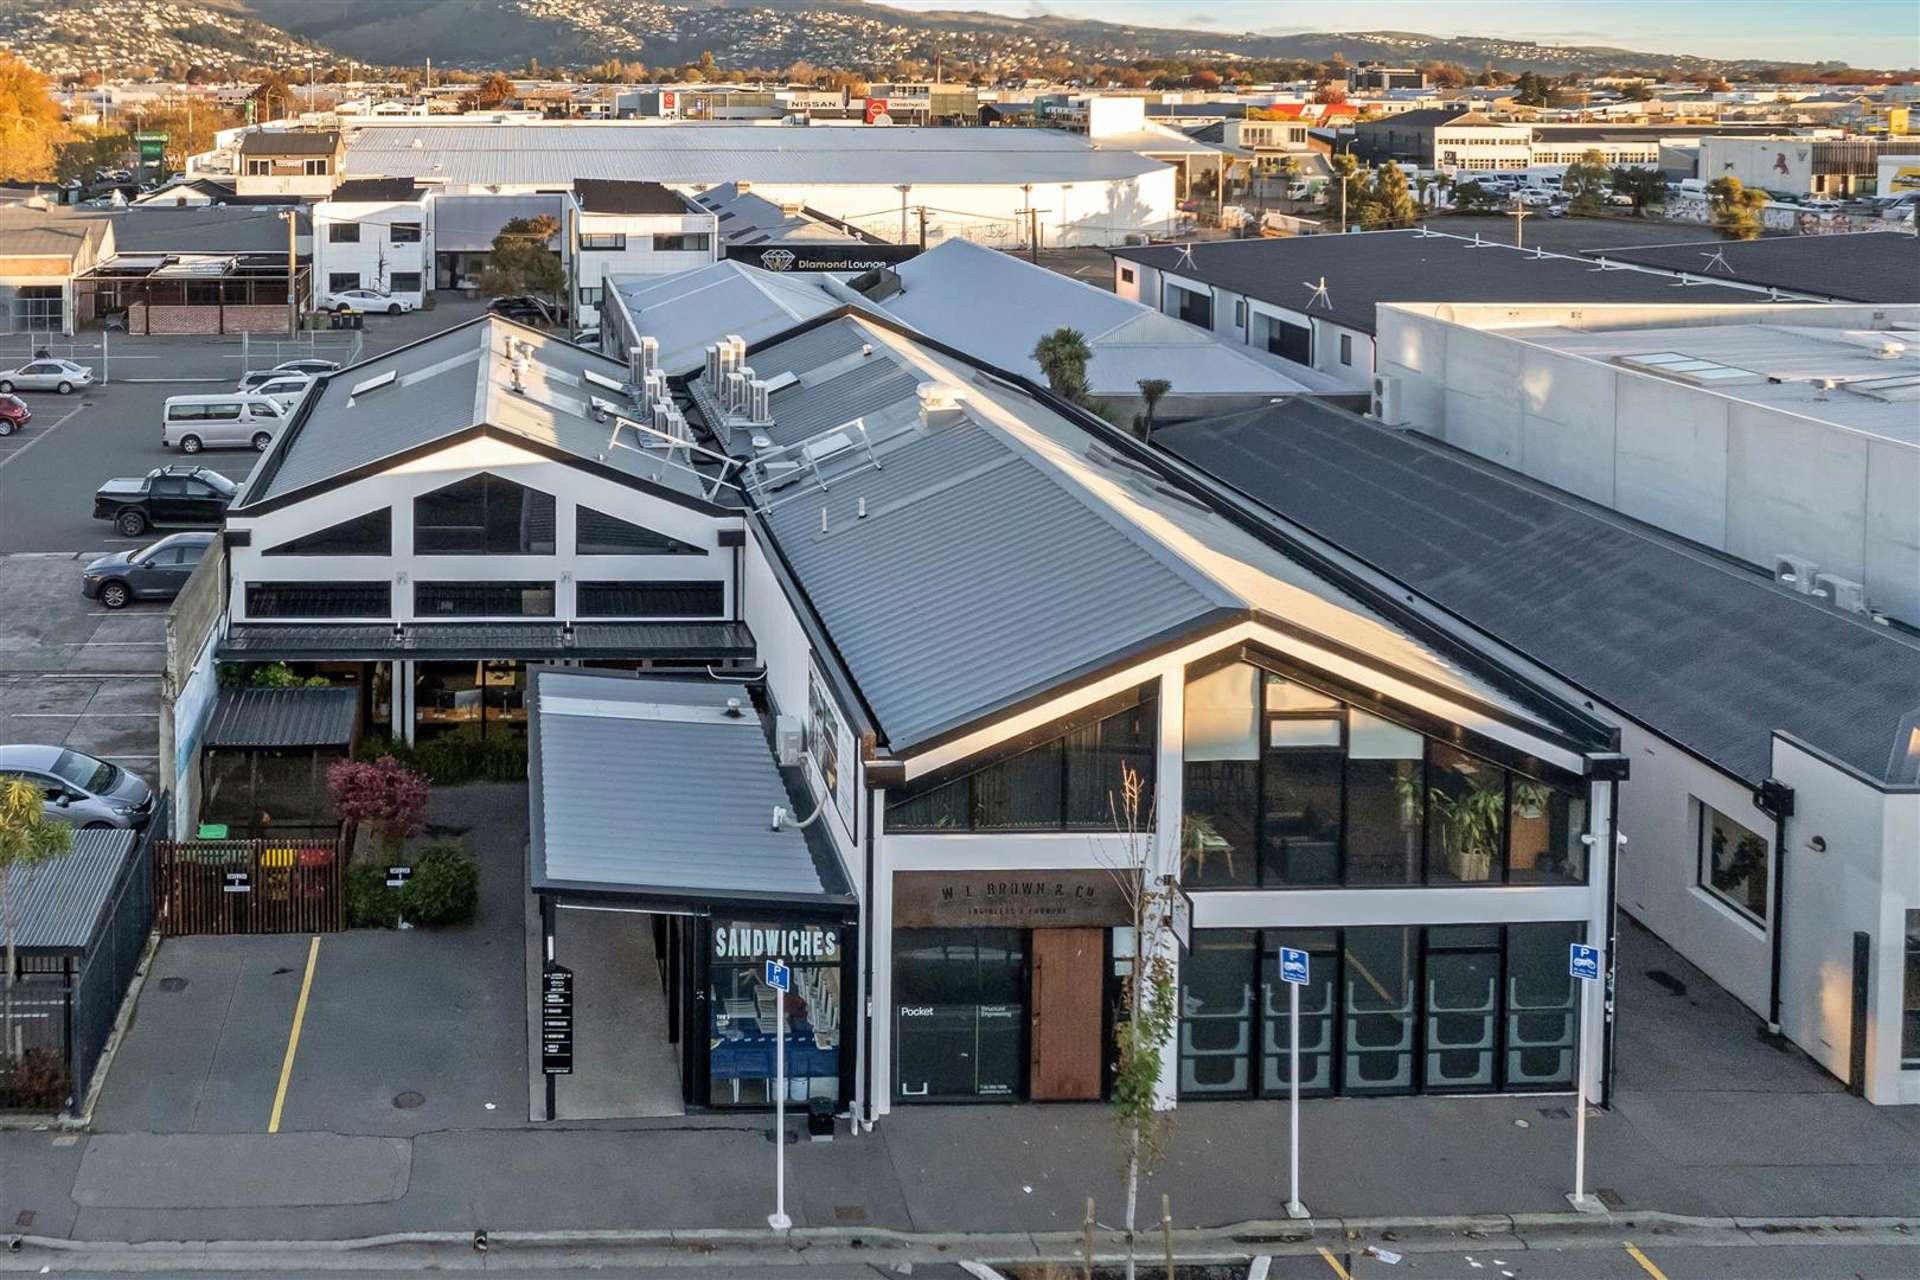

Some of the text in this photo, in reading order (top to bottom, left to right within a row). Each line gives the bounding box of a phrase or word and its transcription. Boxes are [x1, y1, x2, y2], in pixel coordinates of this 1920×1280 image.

[798, 260, 847, 269] Diamond
[942, 887, 953, 900] W
[966, 885, 971, 897] L
[987, 882, 1045, 896] BROWN
[716, 927, 836, 957] SANDWICHES
[1289, 951, 1299, 961] P
[1580, 947, 1590, 958] P
[774, 965, 782, 974] P
[901, 1006, 934, 1017] Pocket
